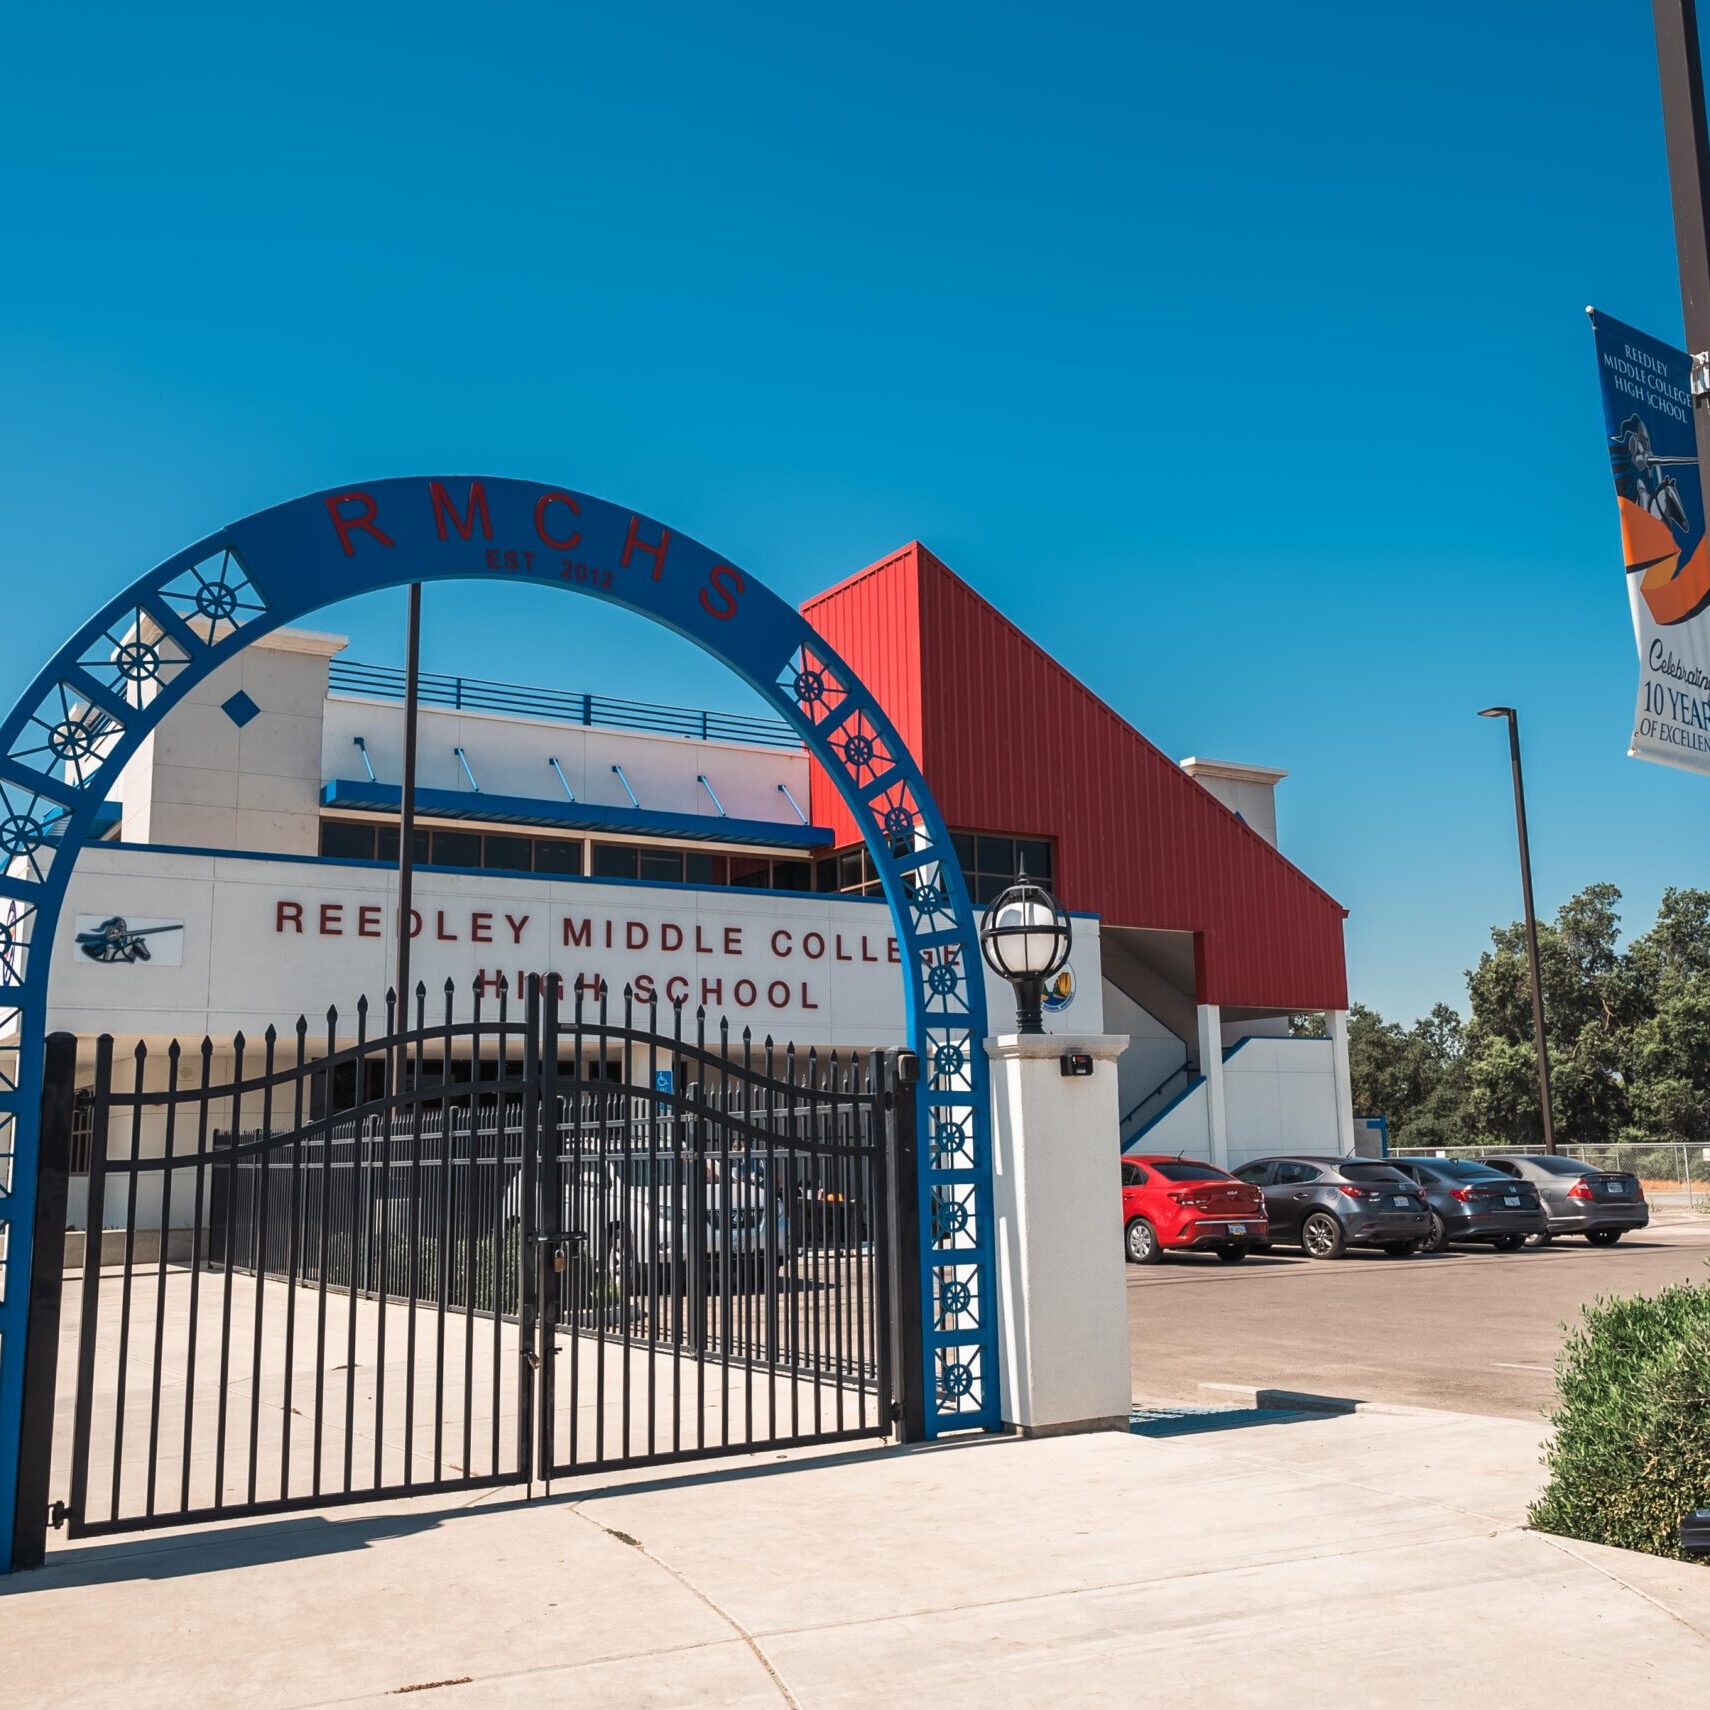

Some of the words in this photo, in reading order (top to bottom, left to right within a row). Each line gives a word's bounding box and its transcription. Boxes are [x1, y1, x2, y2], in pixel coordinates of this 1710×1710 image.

[1624, 344, 1668, 377] REEDLEY
[1603, 352, 1647, 385] MIDDLE
[1647, 374, 1693, 408] COLLEGE
[1614, 375, 1645, 401] HIGH
[1646, 391, 1688, 424] SCHOOL
[486, 548, 536, 572] EST
[1648, 638, 1710, 692] Celebratin
[1643, 680, 1665, 716] 10
[1640, 717, 1658, 737] OF
[562, 917, 743, 955] MIDDLE
[633, 974, 819, 1009] SCHOOL
